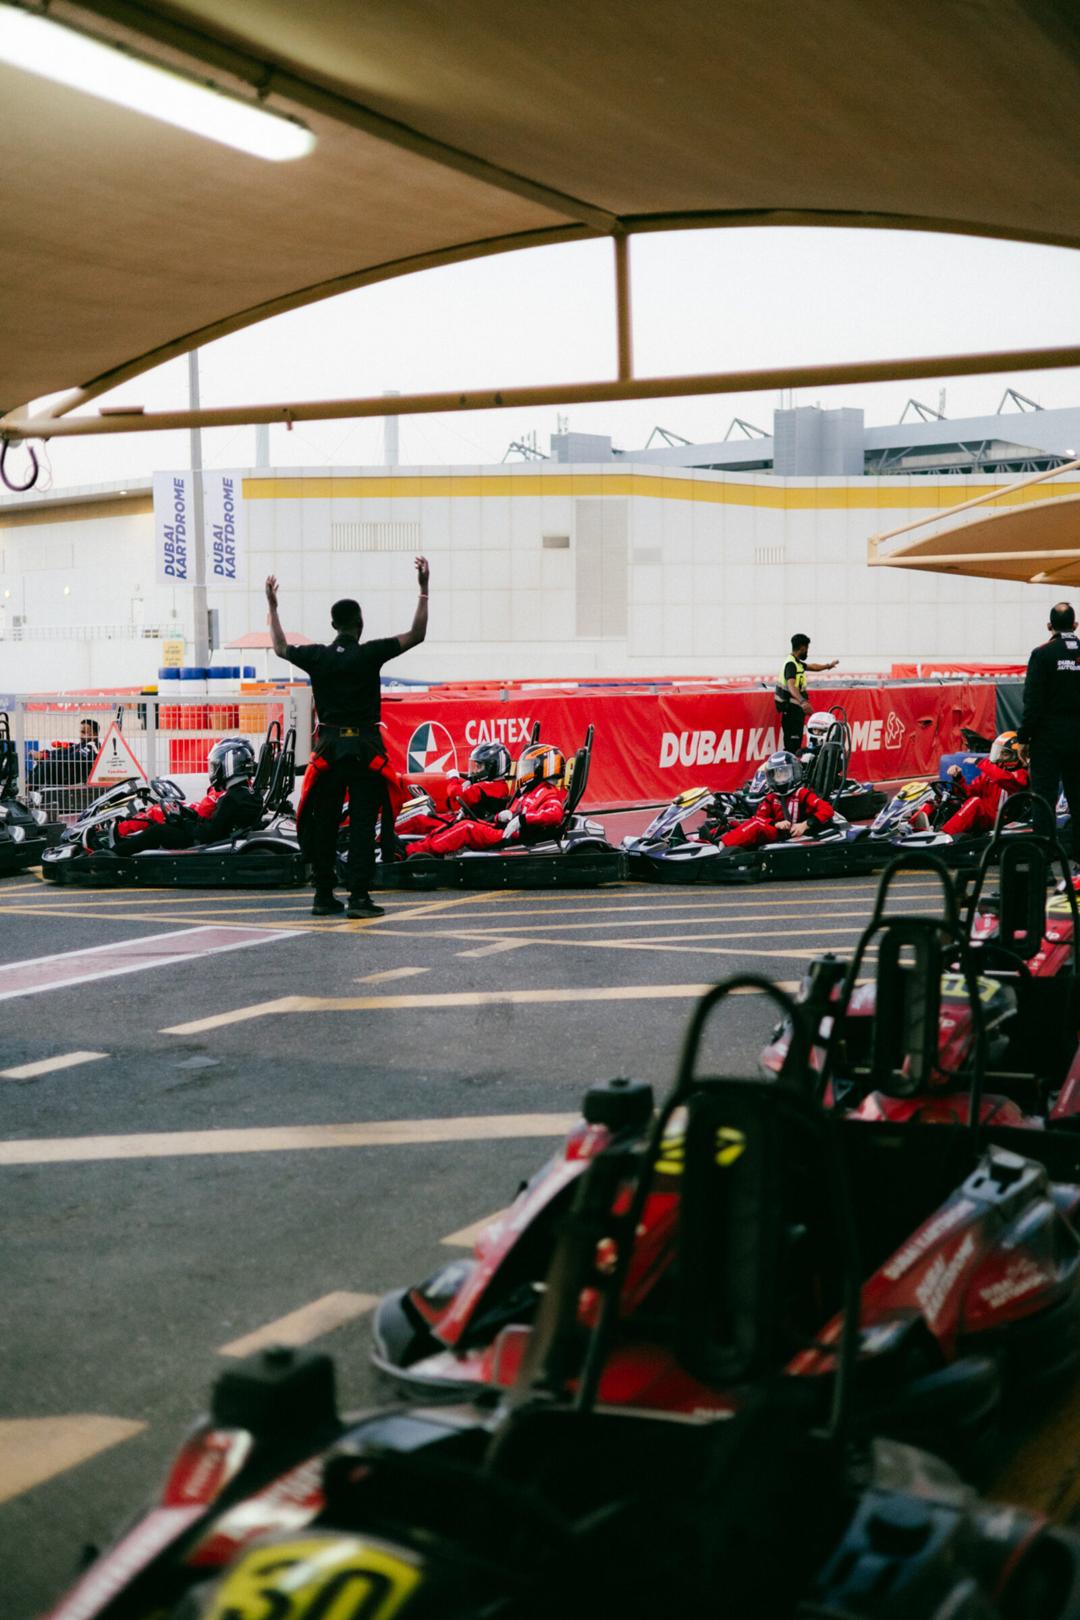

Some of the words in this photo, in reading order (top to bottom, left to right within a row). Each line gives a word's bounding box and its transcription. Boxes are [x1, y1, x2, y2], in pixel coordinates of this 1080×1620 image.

[164, 524, 175, 576] DUBAI
[173, 477, 187, 579] KARTDROME
[214, 524, 225, 575] DUBAI
[222, 477, 236, 579] KARTDROME
[465, 717, 532, 745] CALTEX
[659, 729, 744, 768] DUBAI
